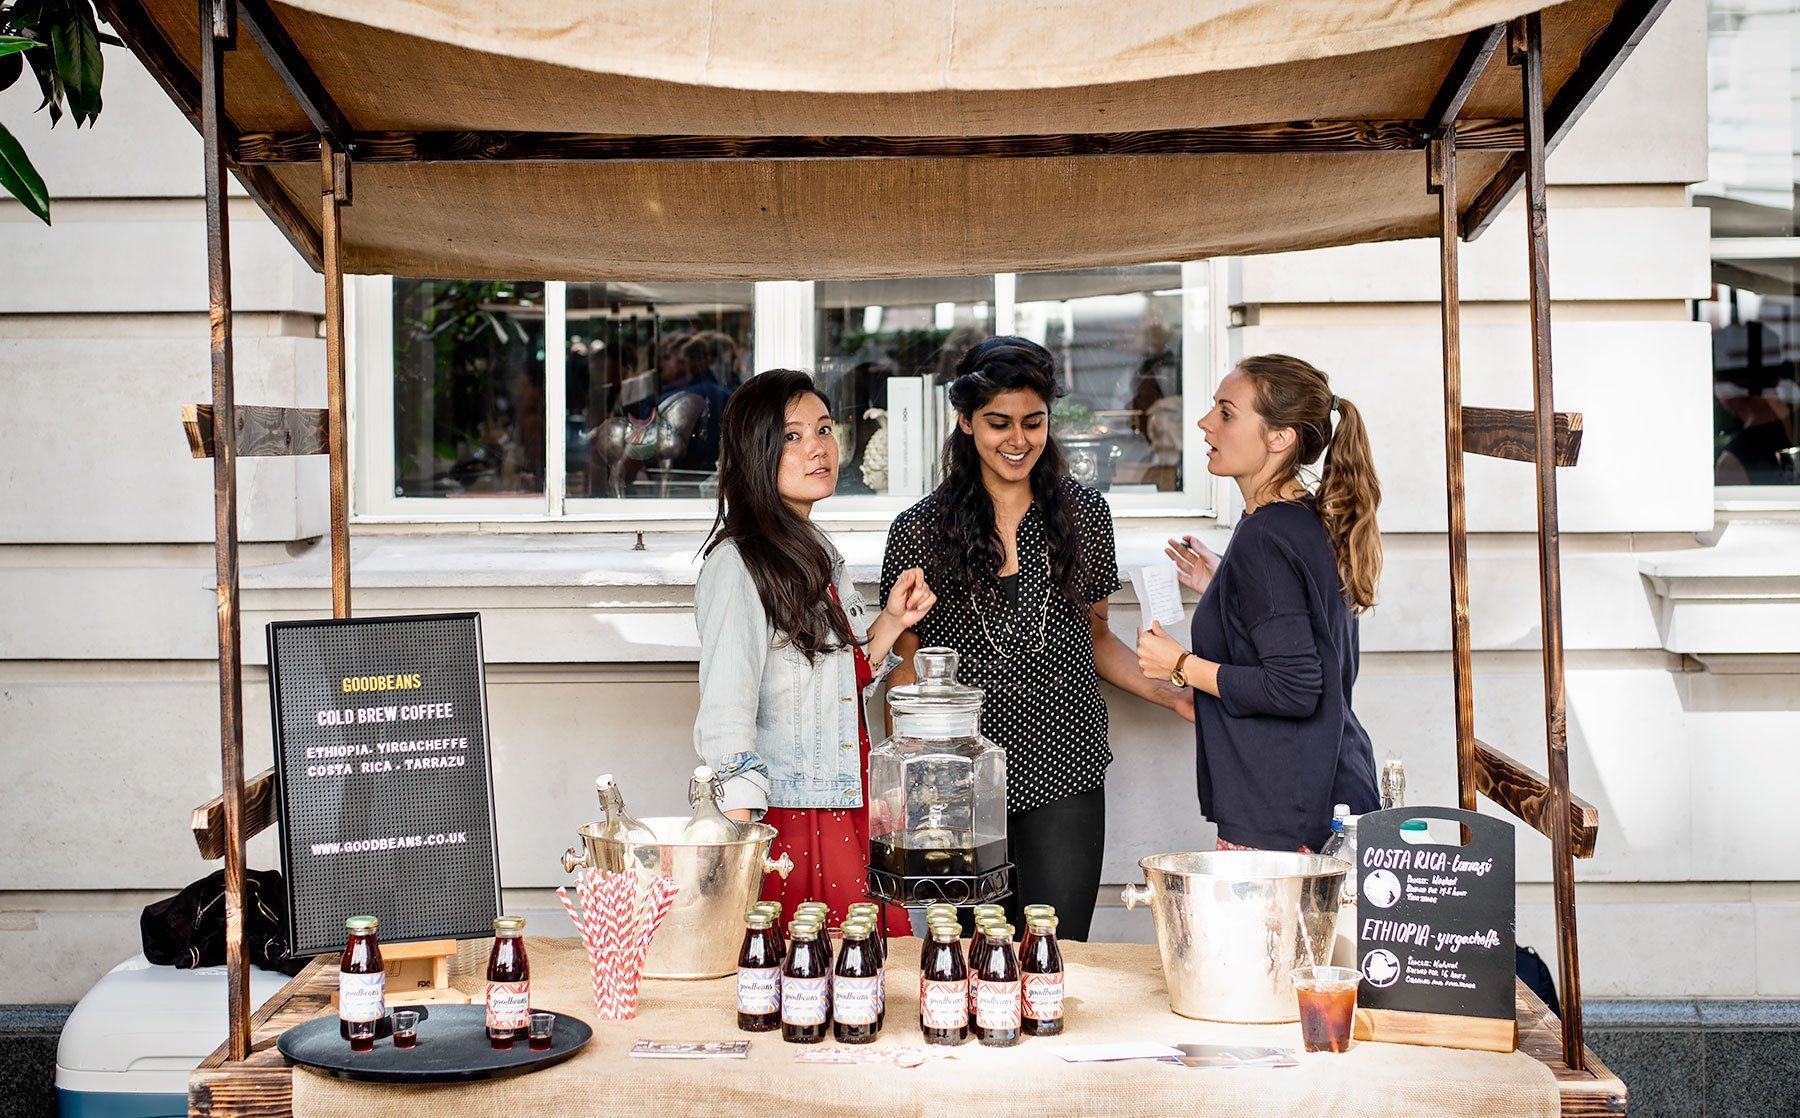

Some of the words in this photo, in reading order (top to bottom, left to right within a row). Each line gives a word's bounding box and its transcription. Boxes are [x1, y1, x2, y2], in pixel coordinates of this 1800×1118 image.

[342, 673, 421, 692] GOODBEANS
[317, 709, 354, 726] COLD
[358, 705, 397, 723] BREW
[401, 702, 453, 721] COFFEE
[377, 737, 468, 754] YIRGACHEFFE
[307, 763, 352, 777] COSTA
[404, 755, 465, 770] TARRAZU
[311, 831, 467, 856] WWW.GOODBEANS.CO.UK
[1363, 846, 1412, 870] COSTA
